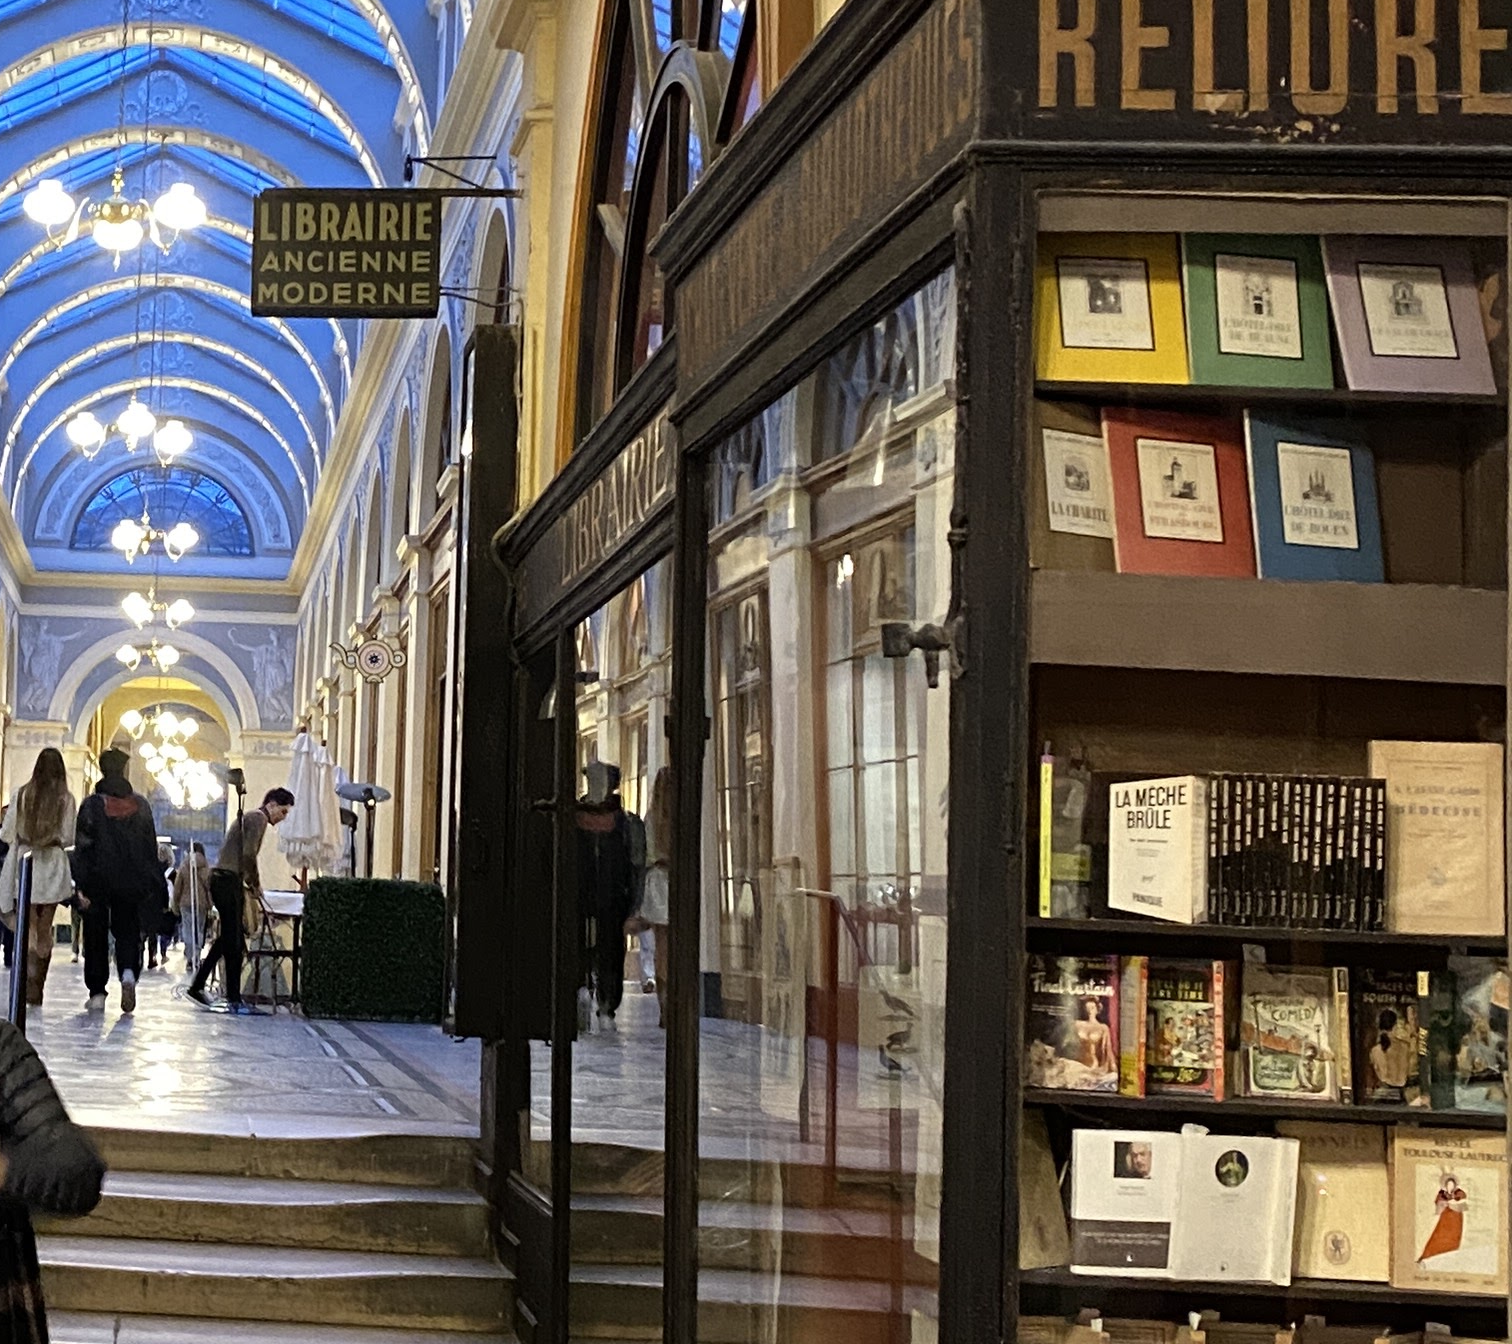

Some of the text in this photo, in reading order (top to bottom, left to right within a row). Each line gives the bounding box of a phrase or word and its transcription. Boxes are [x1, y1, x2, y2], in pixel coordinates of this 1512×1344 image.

[260, 201, 432, 242] LIBRAIRIE
[260, 250, 431, 272] ANCIENNE
[257, 282, 431, 305] MODERNE
[561, 406, 669, 586] LIBRAIRIE
[1115, 790, 1131, 808] LA
[1127, 808, 1171, 830] BRÛLE
[1270, 1005, 1318, 1022] COMEDY
